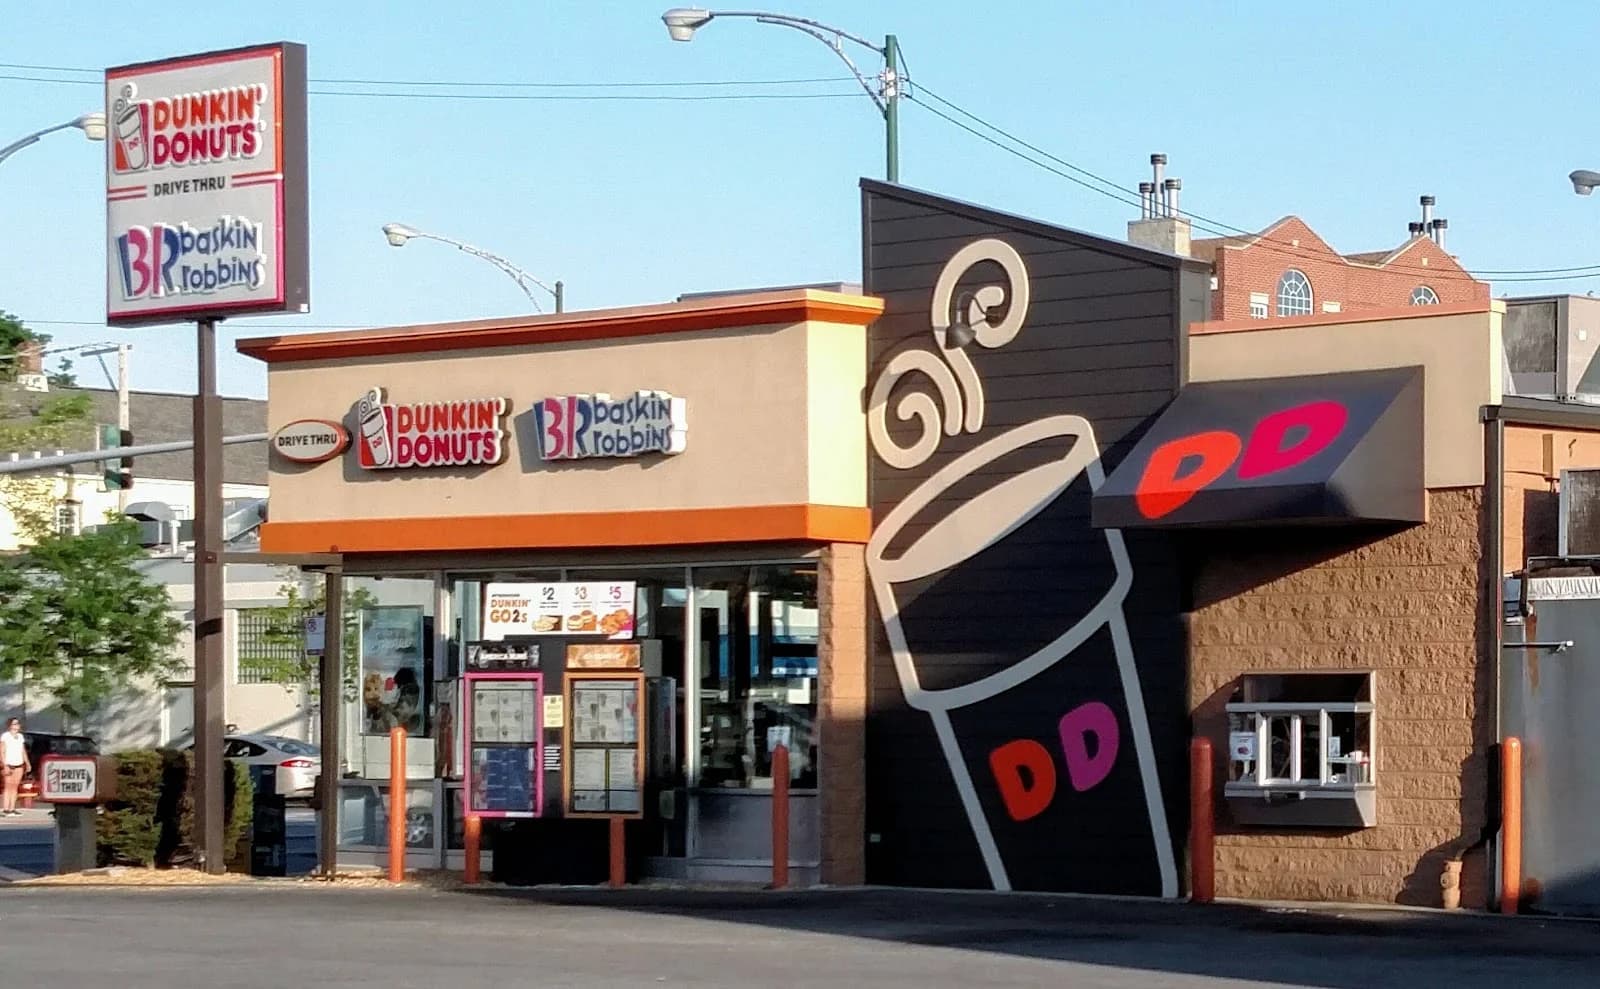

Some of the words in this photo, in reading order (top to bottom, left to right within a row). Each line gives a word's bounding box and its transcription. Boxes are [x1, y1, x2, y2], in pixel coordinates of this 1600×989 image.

[153, 86, 262, 132] DUNKIN'
[153, 122, 257, 165] DONUTS
[154, 180, 190, 197] DRIVE
[192, 176, 226, 193] THRU
[397, 401, 501, 433] DUNKIN'
[278, 435, 308, 447] DRIVE
[310, 433, 338, 446] THRU
[397, 431, 496, 464] DONUTS
[1136, 401, 1348, 519] DD
[542, 586, 555, 600] $2
[574, 586, 588, 600] $3
[609, 586, 622, 600] $5
[989, 702, 1120, 821] DD
[61, 769, 86, 780] DRIVE
[61, 782, 83, 792] THRU
